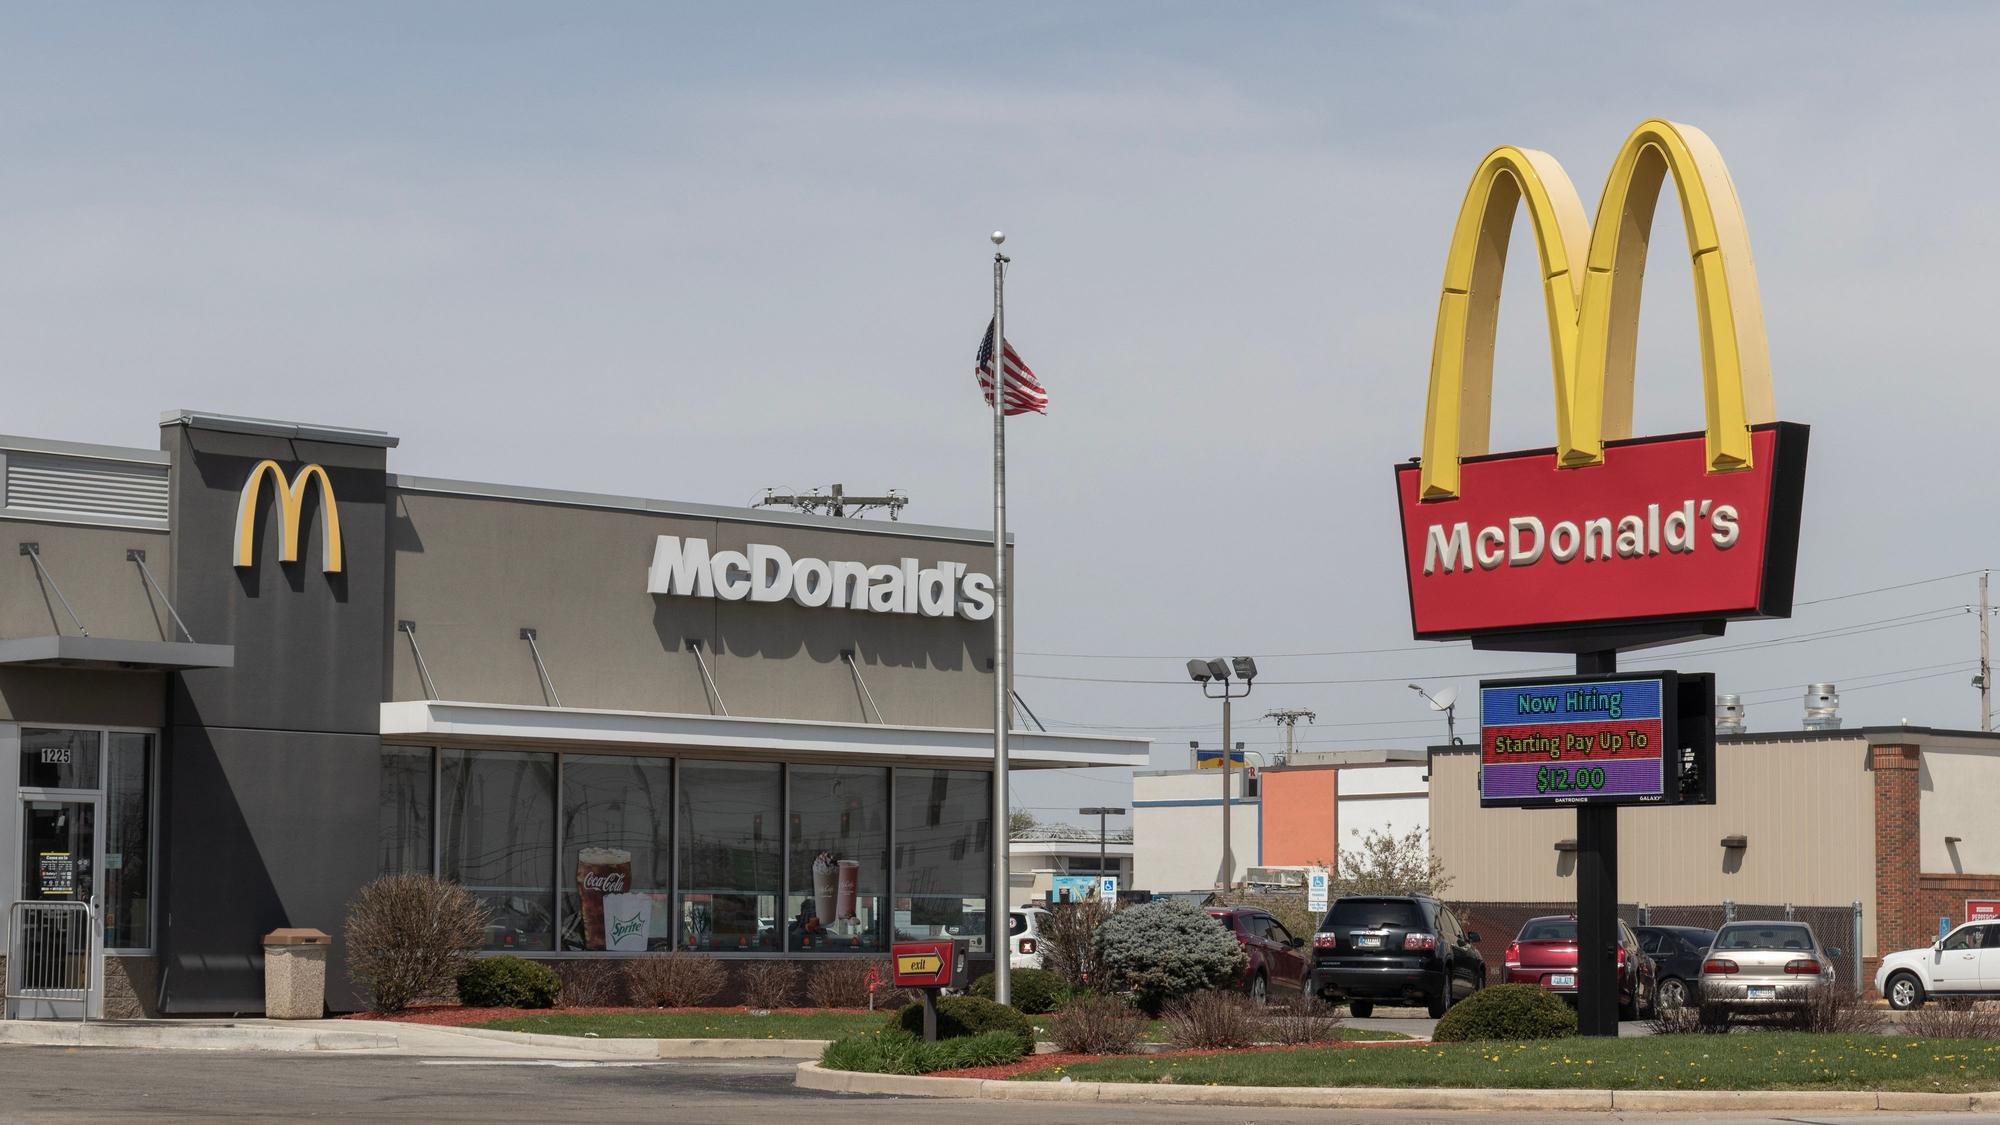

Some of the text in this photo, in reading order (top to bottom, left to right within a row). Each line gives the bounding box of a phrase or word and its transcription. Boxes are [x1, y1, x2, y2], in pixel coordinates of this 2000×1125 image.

[1423, 499, 1740, 575] McDonald's
[647, 534, 995, 621] McDonald's
[1518, 687, 1623, 719] Now Hiring
[43, 749, 70, 763] 1225
[1495, 730, 1648, 759] Starting Pay Up To
[1536, 766, 1605, 793] $12.00
[584, 871, 625, 892] Coca-Cola
[612, 921, 642, 937] Sprite
[910, 959, 926, 971] exit
